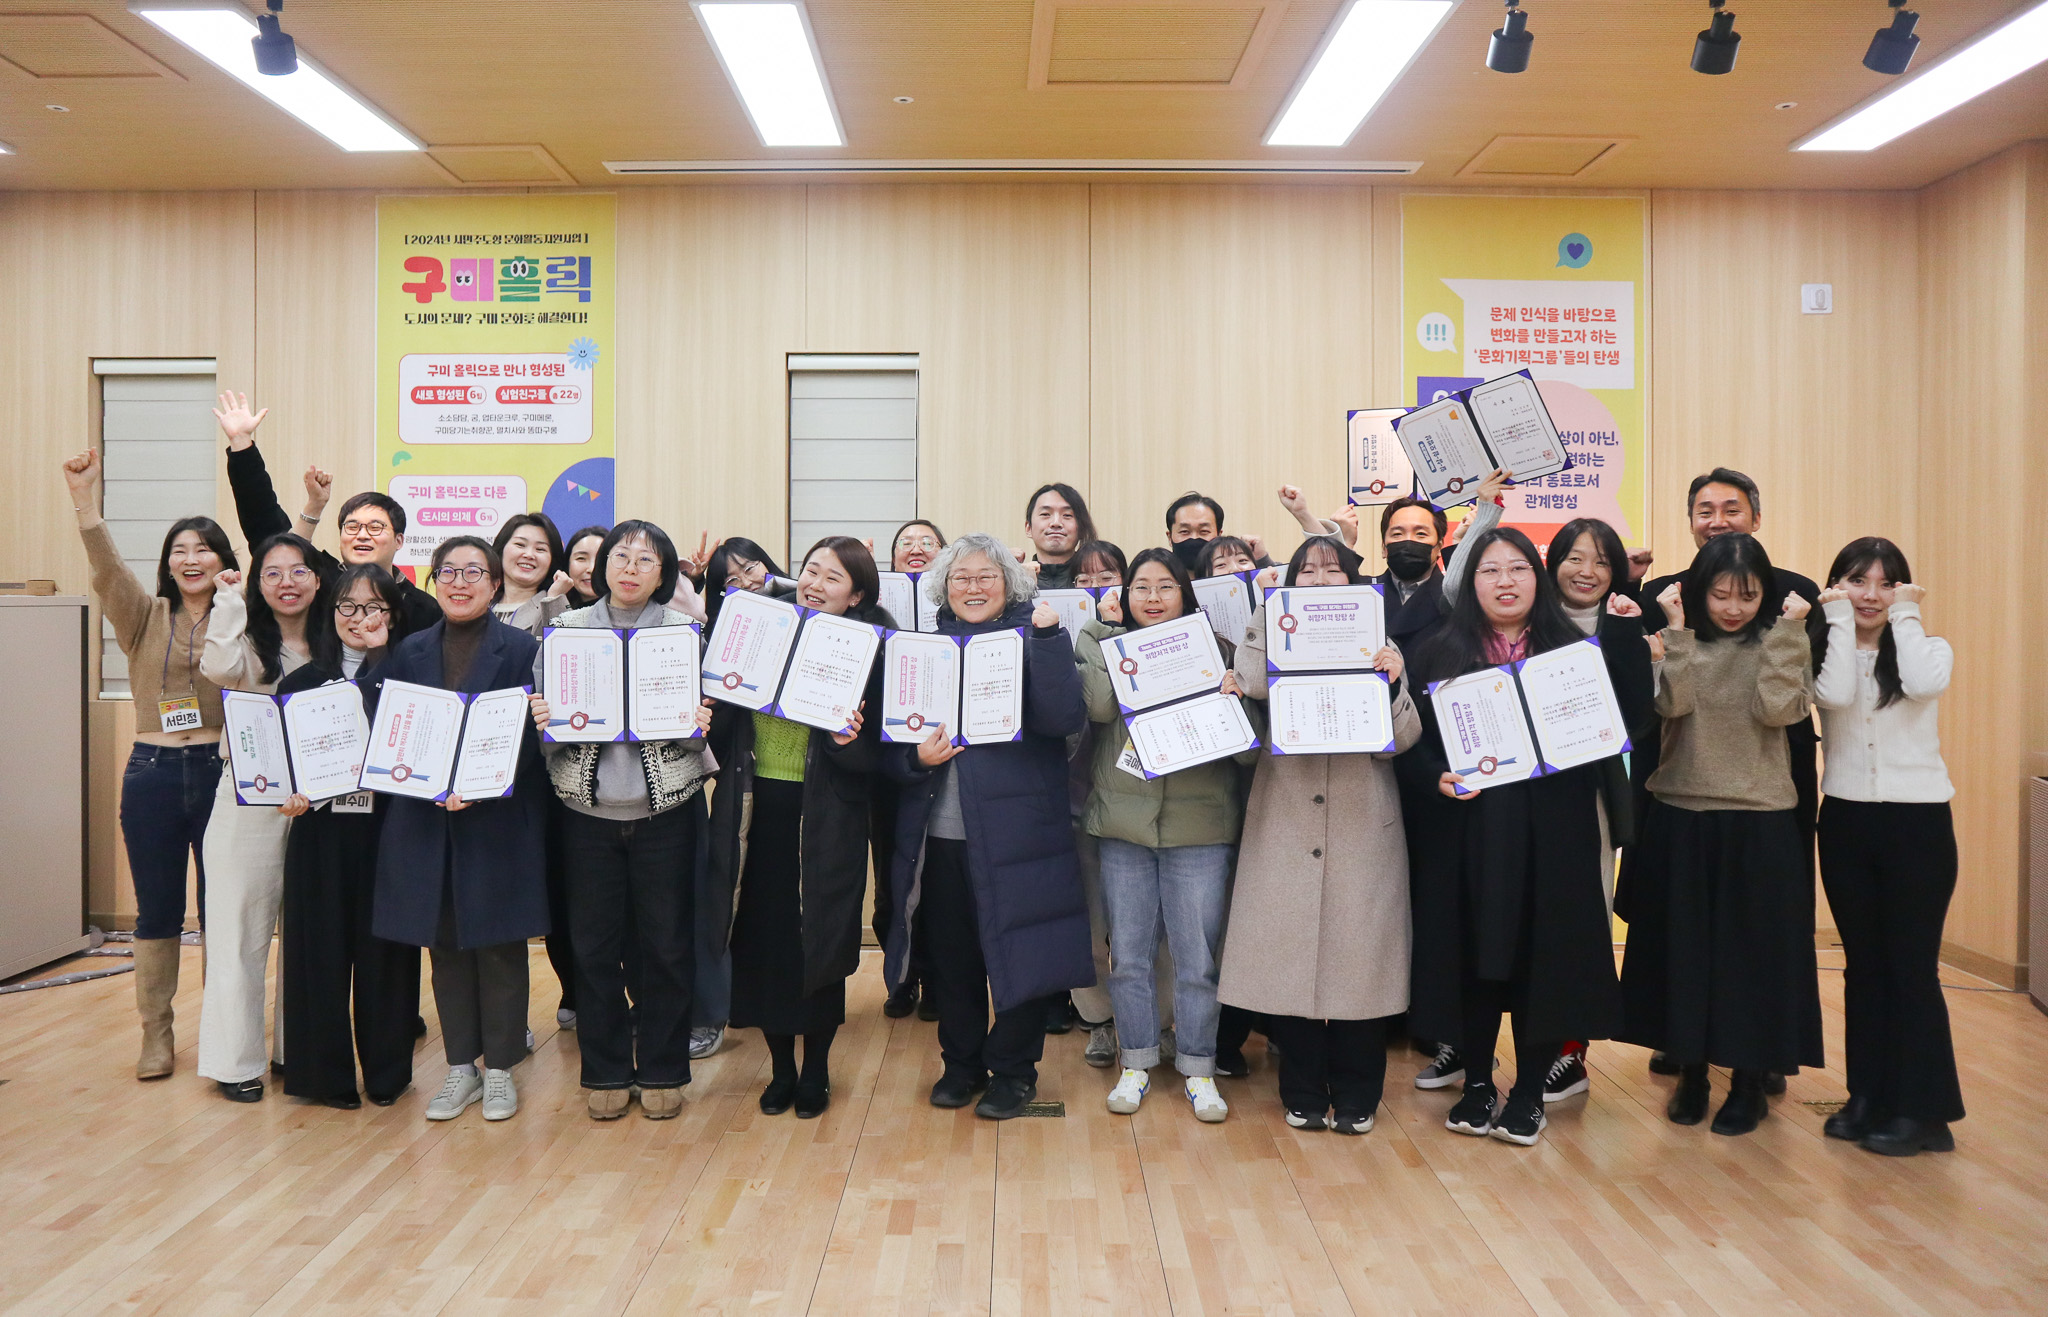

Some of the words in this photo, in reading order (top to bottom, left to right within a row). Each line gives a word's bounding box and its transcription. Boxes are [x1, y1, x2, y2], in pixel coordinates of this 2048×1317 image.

[411, 234, 450, 245] 2024년
[402, 256, 591, 304] 구미홀릭
[405, 312, 438, 325] 도시의
[441, 312, 472, 325] 문제?
[475, 312, 498, 325] 구미
[501, 312, 535, 325] 문화로
[537, 312, 588, 325] 해결한다!
[1490, 307, 1516, 322] 문제
[1520, 307, 1560, 323] 인식을
[1563, 308, 1617, 323] 바탕으로
[1490, 328, 1530, 343] 변화를
[1534, 328, 1587, 344] 만들고자
[1590, 329, 1617, 344] 하는
[1593, 350, 1620, 365] 탄생
[427, 364, 450, 377] 구미
[454, 364, 500, 377] 홀릭으로
[503, 364, 526, 377] 만나
[529, 363, 565, 377] 형성된
[415, 389, 435, 401] 새로
[436, 389, 465, 401] 형성된
[500, 388, 547, 401] 실험친구들
[1589, 431, 1619, 446] 아닌,
[1546, 473, 1600, 488] 동료로서
[407, 486, 431, 499] 구미
[434, 486, 481, 499] 홀릭으로
[484, 486, 508, 499] 다룬
[1525, 493, 1578, 509] 관계형성
[421, 511, 450, 522] 도시의
[452, 511, 471, 522] 의제
[480, 512, 493, 522] 6개
[1349, 613, 1355, 621] 상
[166, 712, 198, 727] 서민정
[335, 795, 369, 807] 배수미
